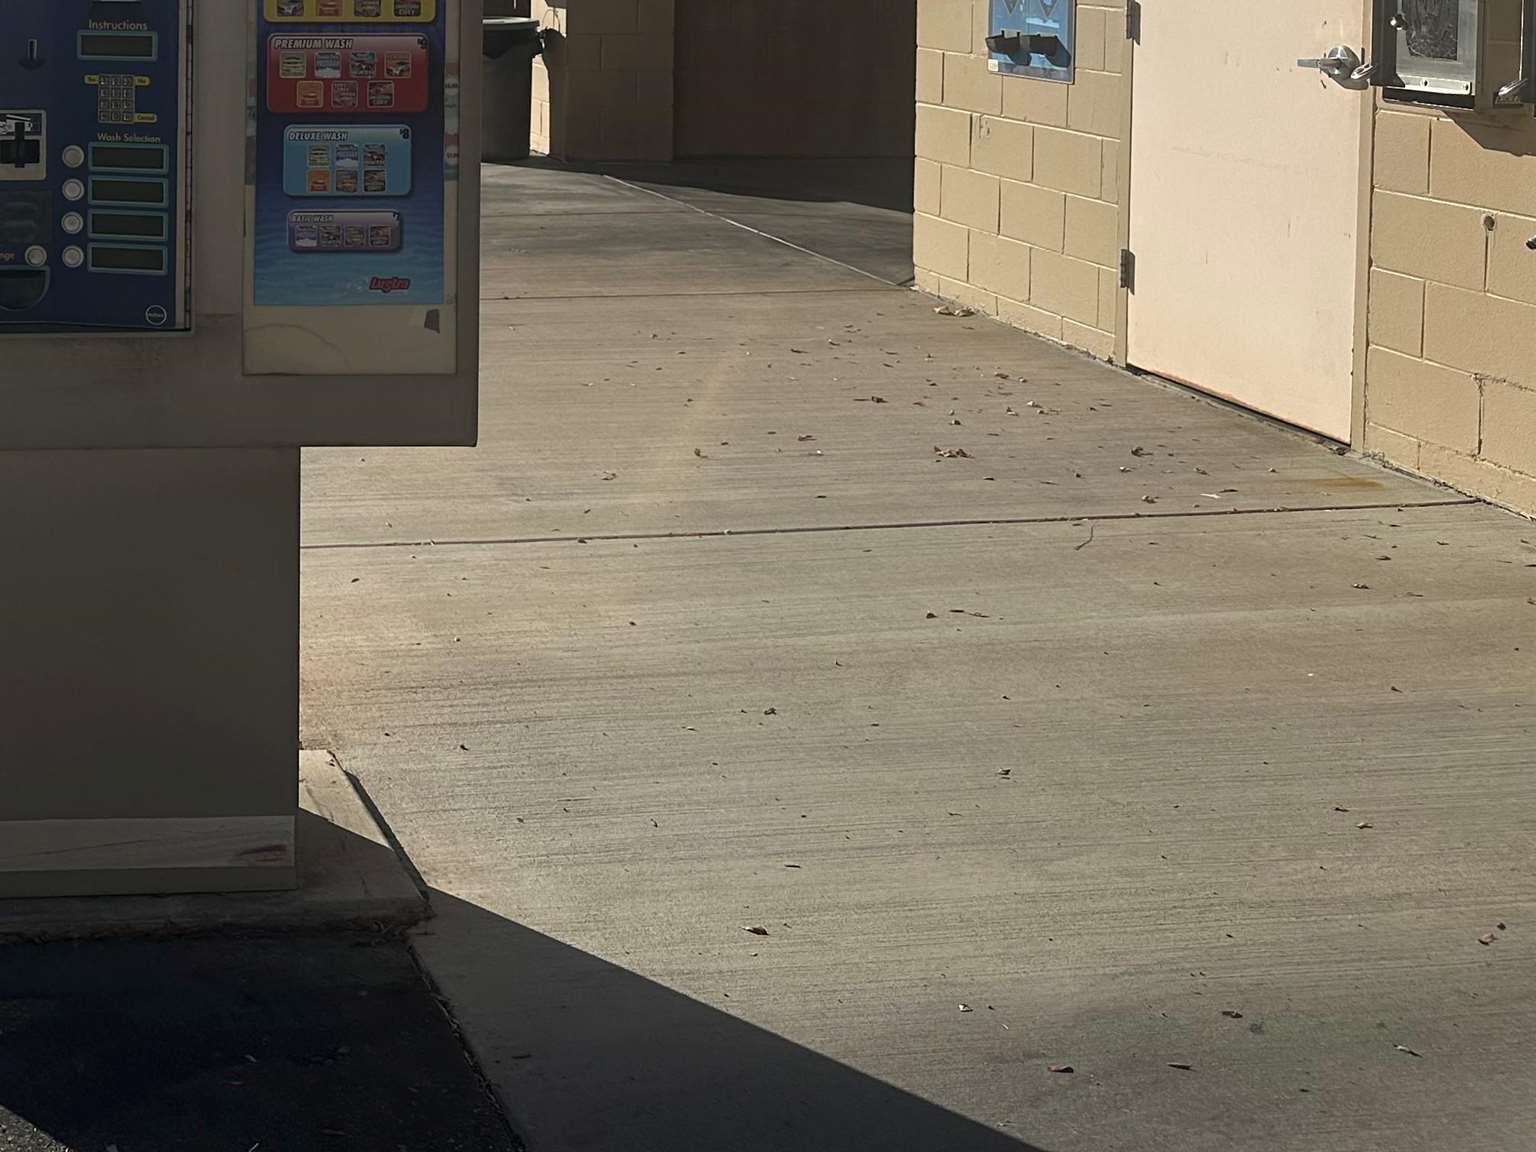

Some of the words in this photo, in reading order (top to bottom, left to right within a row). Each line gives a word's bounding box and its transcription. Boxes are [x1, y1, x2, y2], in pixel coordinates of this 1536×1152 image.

[88, 18, 149, 31] Instructions
[275, 38, 323, 49] PREMIUM
[324, 38, 354, 49] WASH
[97, 131, 121, 142] Wash
[322, 131, 349, 142] WASH
